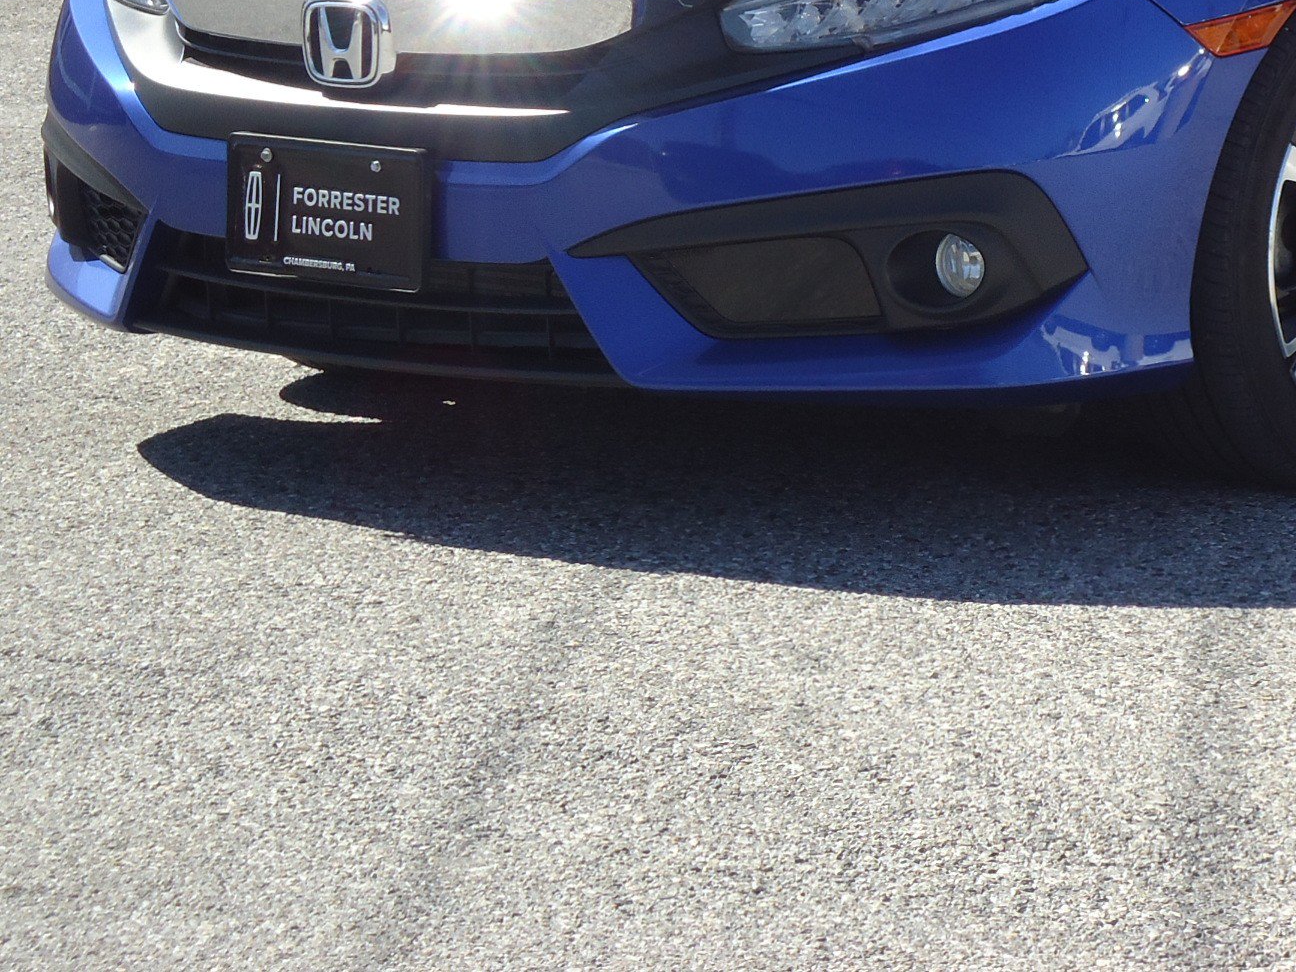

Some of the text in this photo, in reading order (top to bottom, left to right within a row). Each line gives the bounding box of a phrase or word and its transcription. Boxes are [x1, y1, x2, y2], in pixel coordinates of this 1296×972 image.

[293, 187, 401, 215] FORRESTER
[291, 215, 373, 241] LINCOLN
[283, 256, 356, 272] CHAMBERSBURG, PA
